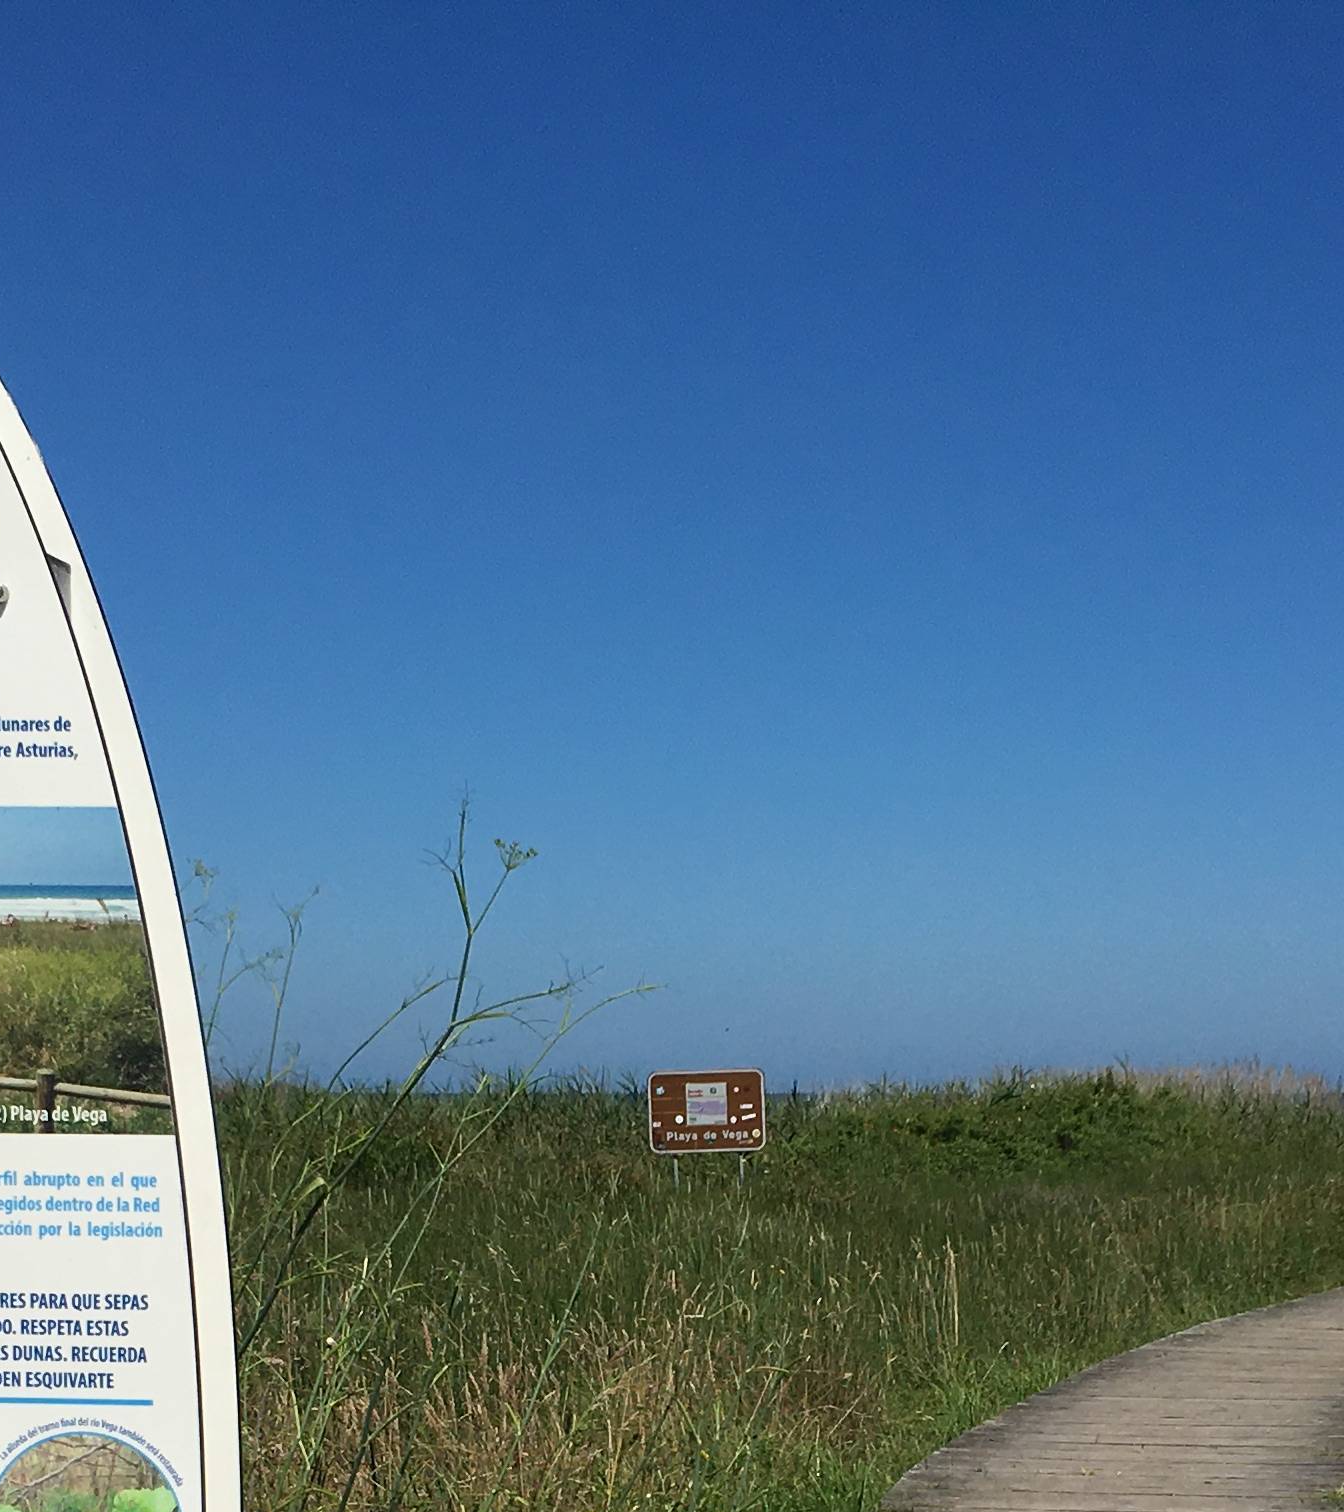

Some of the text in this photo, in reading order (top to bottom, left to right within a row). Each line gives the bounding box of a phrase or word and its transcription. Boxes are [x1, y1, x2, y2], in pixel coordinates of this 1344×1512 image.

[9, 1105, 48, 1125] Playa
[51, 1104, 69, 1126] de
[71, 1104, 110, 1126] Vega
[666, 1129, 750, 1142] Playa de Vega
